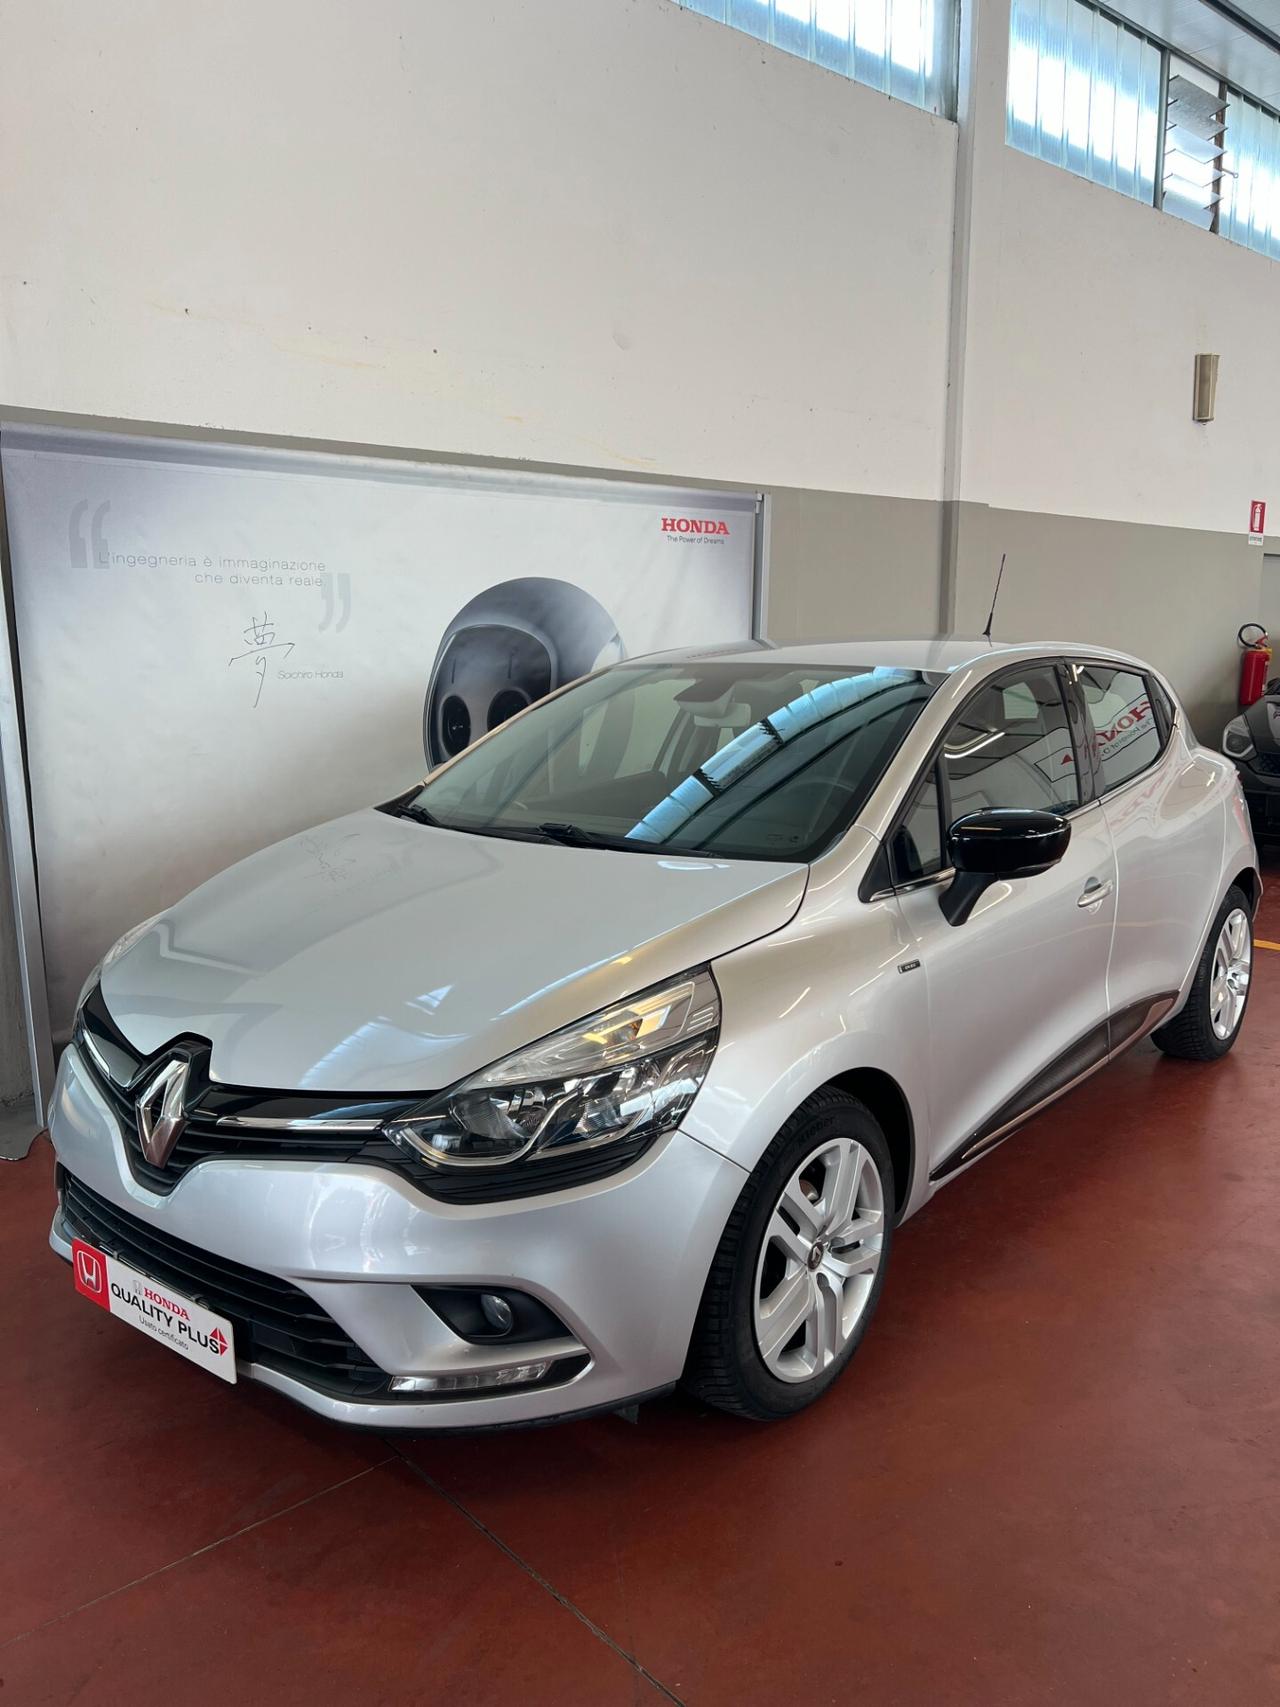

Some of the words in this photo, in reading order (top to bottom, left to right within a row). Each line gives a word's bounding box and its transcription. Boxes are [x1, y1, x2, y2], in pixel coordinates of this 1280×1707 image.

[661, 518, 730, 535] HONDA
[679, 536, 696, 544] Power
[99, 551, 196, 568] L'ingegneria
[203, 556, 212, 567] è
[219, 556, 326, 573] immaginazione
[194, 573, 224, 584] che
[229, 574, 283, 586] diventa
[144, 1287, 190, 1321] HONDA
[111, 1283, 173, 1328] QUALITY
[178, 1320, 219, 1354] PLUS
